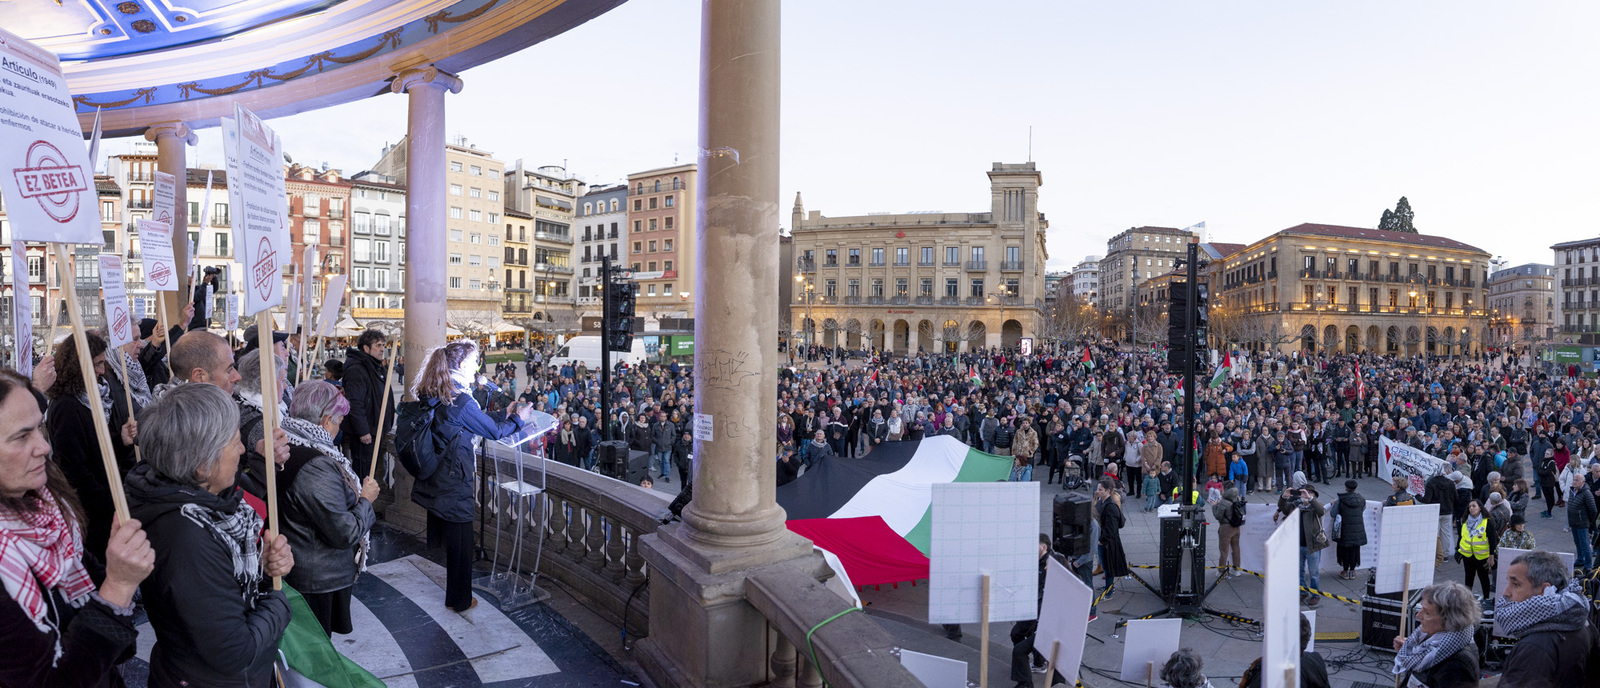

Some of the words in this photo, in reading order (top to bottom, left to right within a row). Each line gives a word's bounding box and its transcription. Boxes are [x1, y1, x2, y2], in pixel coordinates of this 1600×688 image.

[24, 174, 42, 192] EZ
[42, 172, 78, 190] BETEA
[255, 267, 261, 282] EZ
[261, 258, 274, 277] BETEA
